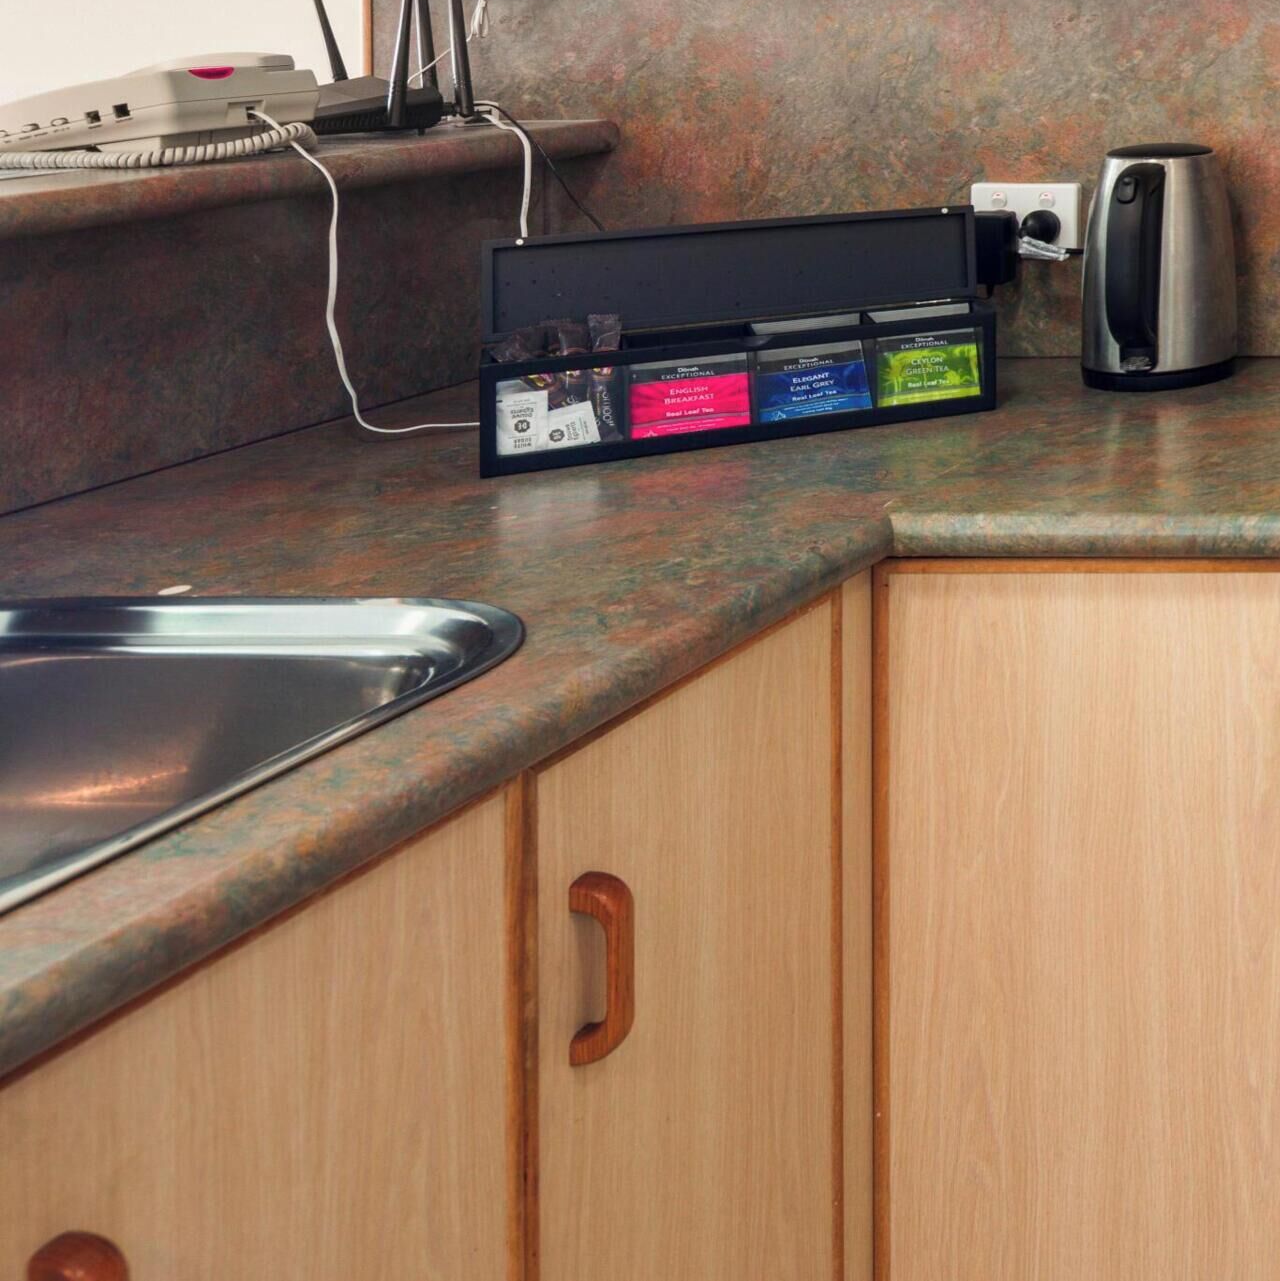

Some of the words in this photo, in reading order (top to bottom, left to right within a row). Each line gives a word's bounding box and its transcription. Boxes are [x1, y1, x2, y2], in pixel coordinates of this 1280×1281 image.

[901, 340, 948, 350] EXCEPTIONAL
[784, 359, 833, 371] EXCEPTIONAL
[911, 356, 944, 365] CEYLON
[661, 370, 715, 380] EXCEPTIONAL
[906, 367, 933, 375] GREEN
[792, 372, 830, 384] ELEGANT
[669, 385, 708, 396] ENGLISH
[790, 384, 812, 392] EARL
[812, 380, 835, 388] GREY
[664, 393, 715, 405] BREAKFAST
